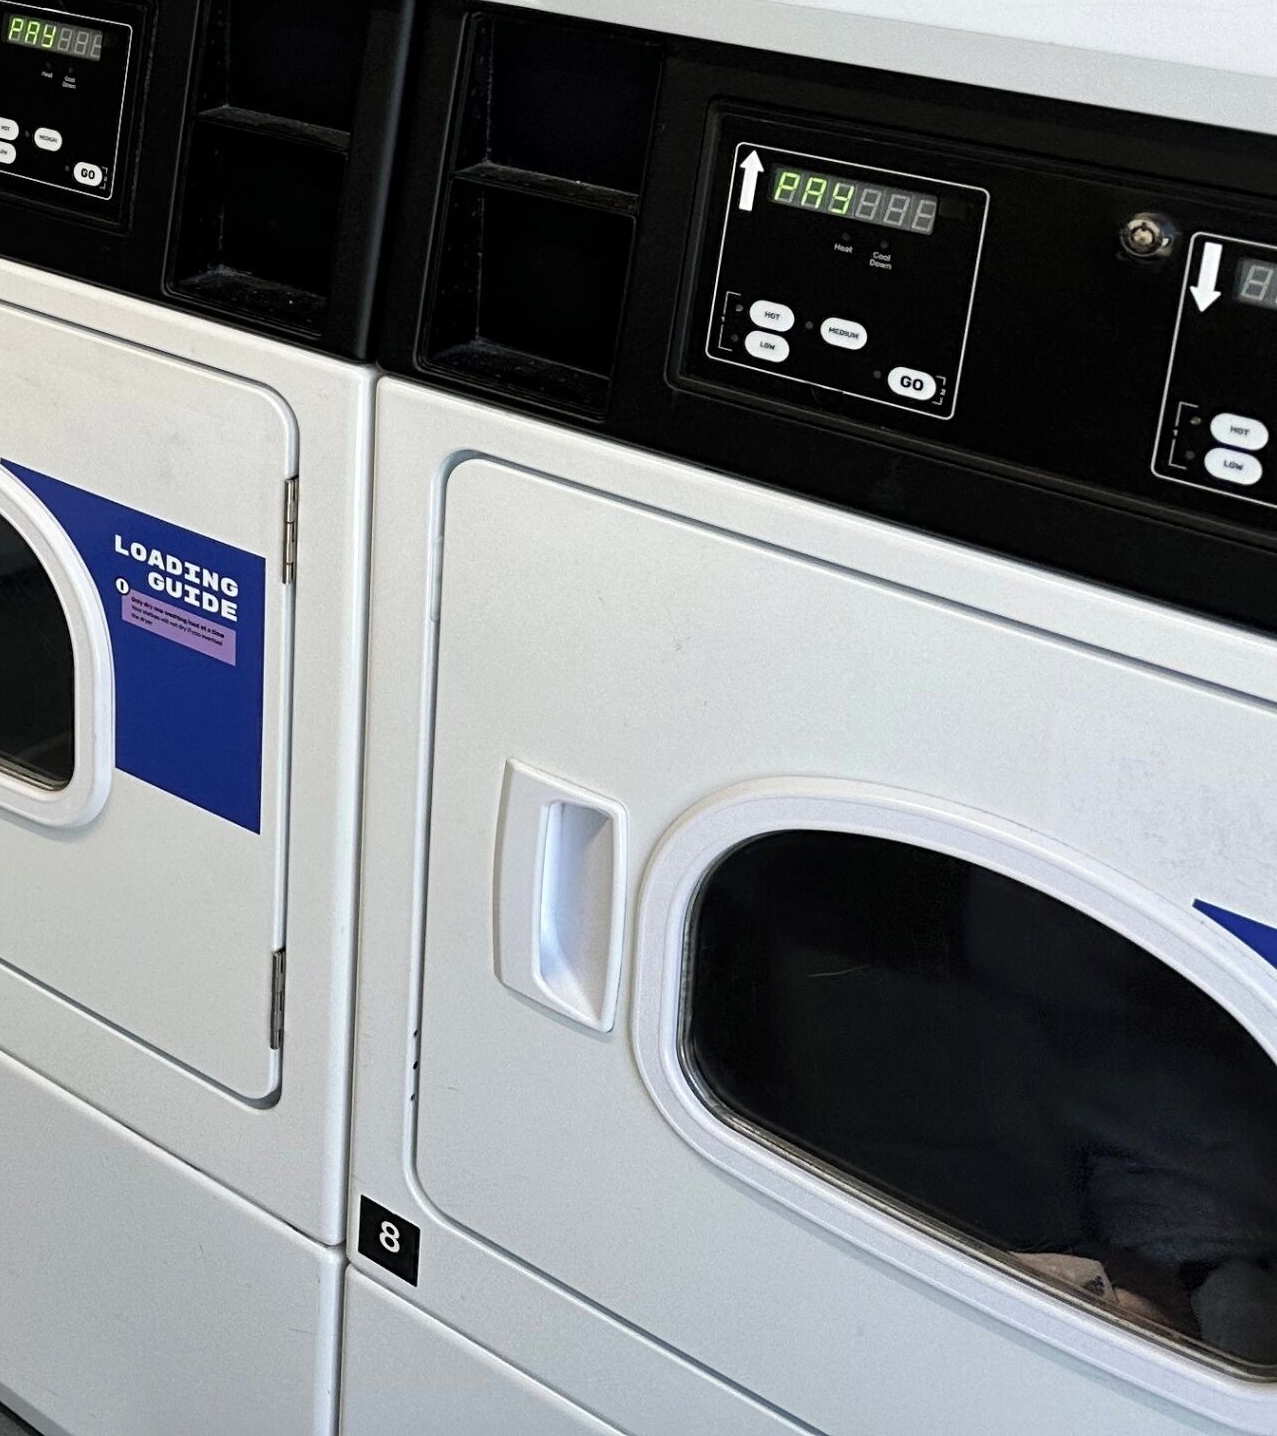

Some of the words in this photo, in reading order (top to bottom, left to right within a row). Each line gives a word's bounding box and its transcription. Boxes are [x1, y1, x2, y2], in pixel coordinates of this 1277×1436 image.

[8, 17, 57, 48] PAY
[80, 167, 96, 180] GO
[773, 171, 855, 215] PAY
[900, 374, 925, 393] GO
[115, 534, 239, 597] LOADING
[147, 571, 238, 622] GUIDE
[379, 1220, 401, 1253] 8
